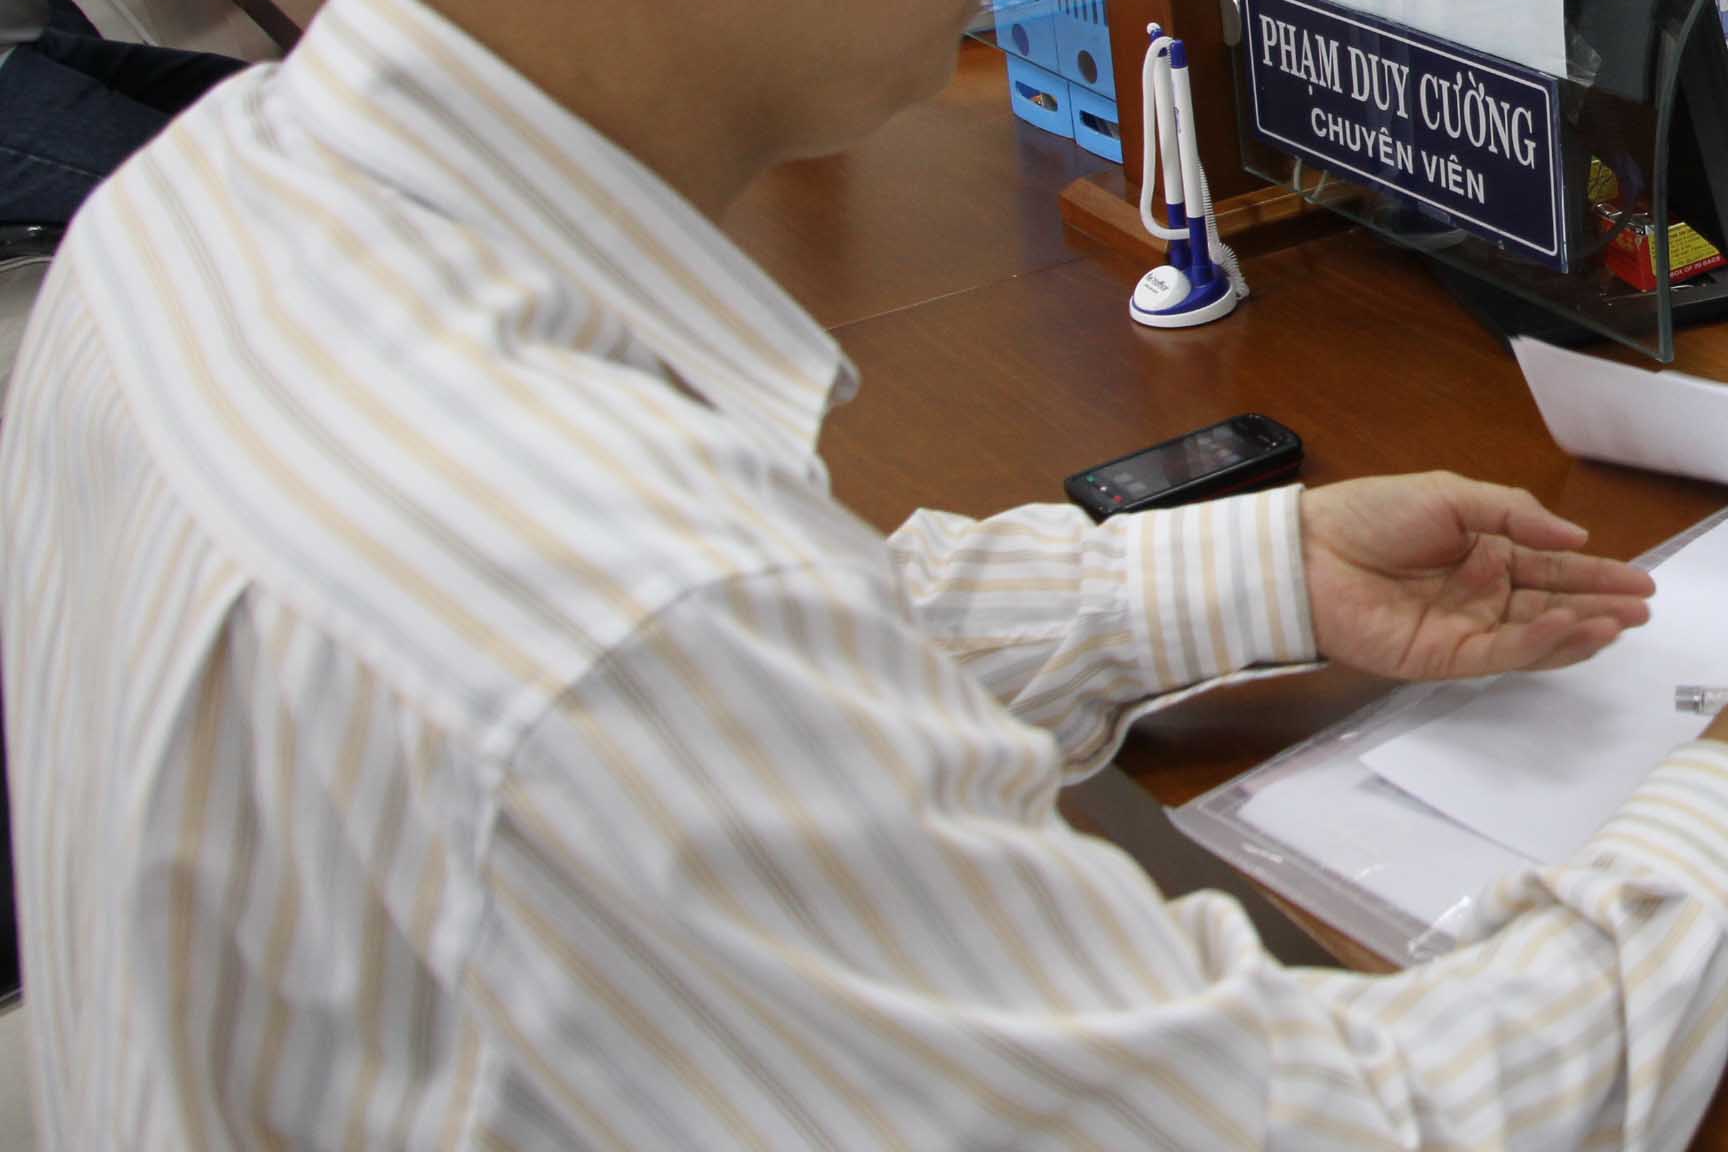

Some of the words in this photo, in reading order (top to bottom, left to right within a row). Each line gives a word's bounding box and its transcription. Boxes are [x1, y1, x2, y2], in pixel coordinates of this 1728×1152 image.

[1258, 13, 1343, 96] PHẠM
[1347, 45, 1410, 120] DUY
[1418, 70, 1537, 170] CƯỜNG
[1310, 107, 1415, 175] CHUYÊN
[1420, 149, 1486, 205] VIÊN
